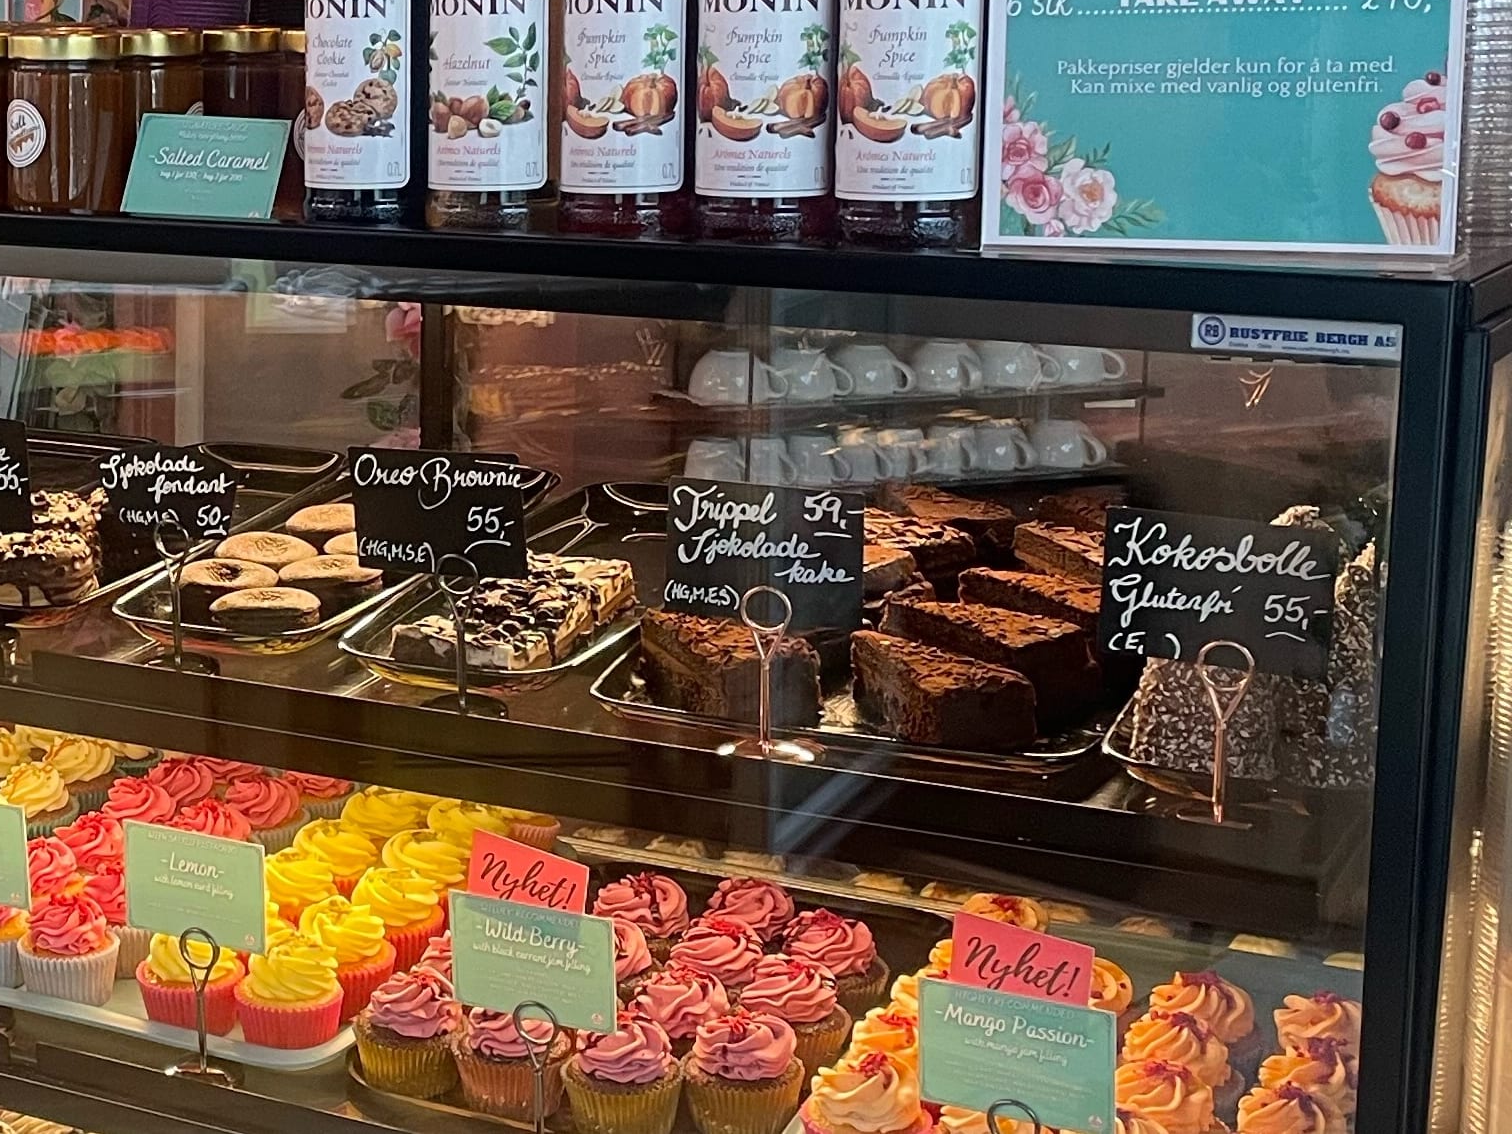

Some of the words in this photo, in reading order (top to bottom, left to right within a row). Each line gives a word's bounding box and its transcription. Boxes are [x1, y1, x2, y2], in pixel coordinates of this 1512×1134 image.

[577, 28, 626, 47] Pumpkin
[726, 26, 783, 46] Pumpkin
[868, 25, 927, 46] Pumpkin
[584, 47, 616, 69] Spice
[736, 46, 771, 69] Spice
[879, 45, 916, 67] Spice
[1056, 60, 1162, 79] Pakkepriser
[1165, 58, 1230, 78] gjelder
[1234, 58, 1272, 75] kun
[1276, 57, 1306, 74] for
[1309, 57, 1321, 74] å
[1325, 59, 1349, 74] ta
[1071, 78, 1106, 95] Kan
[1109, 78, 1156, 95] mixe
[1159, 77, 1201, 94] med
[1205, 76, 1263, 97] vanlig
[1268, 78, 1291, 97] og
[1295, 75, 1383, 97] glutenfri.
[207, 149, 270, 171] Caramel
[1230, 326, 1309, 343] RUSTFRIE
[1316, 331, 1368, 346] BERGH
[1374, 336, 1397, 348] AS
[100, 449, 205, 490] Sjokolade
[354, 453, 418, 486] Oreo
[418, 457, 521, 510] Brownie
[148, 473, 234, 505] fondant
[673, 485, 777, 532] Trippel
[466, 506, 516, 540] 55,-
[677, 528, 822, 564] Sjokolade
[1107, 517, 1332, 581] Kokosbolle
[1109, 573, 1242, 629] Glutenfri
[1263, 594, 1329, 631] 55,-
[480, 852, 577, 910] Nyhet!
[965, 936, 1081, 998] Nyhet!
